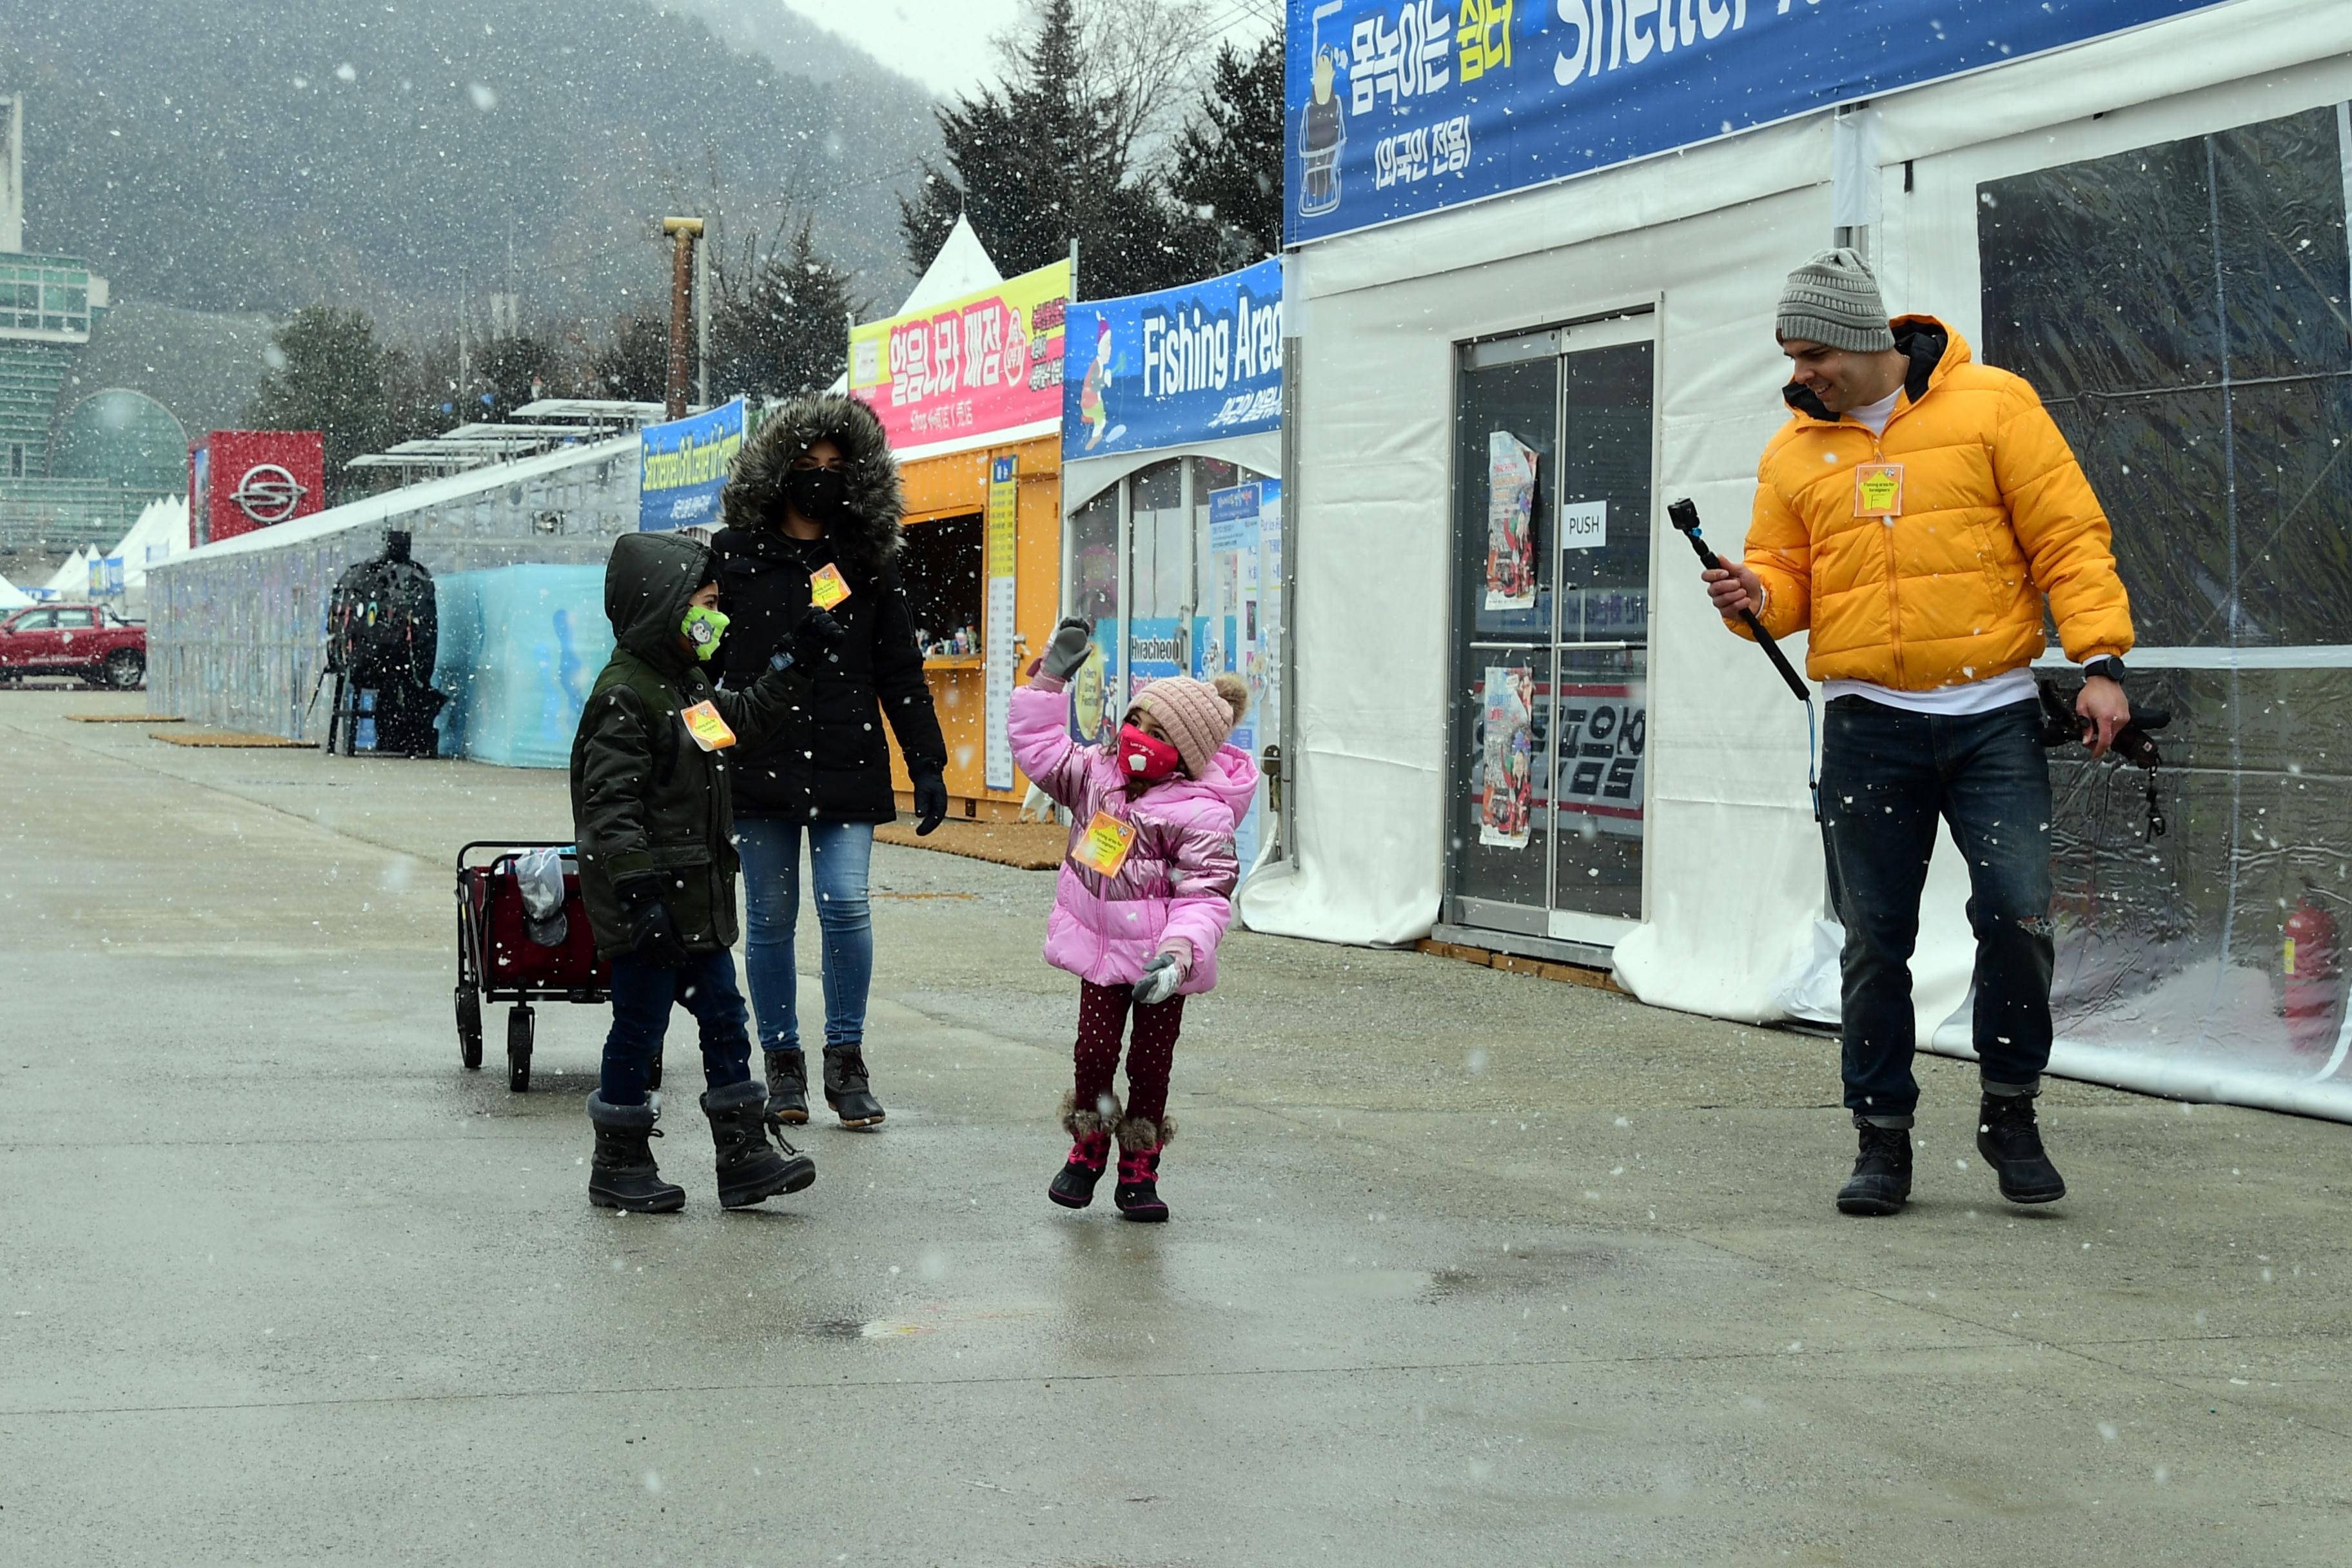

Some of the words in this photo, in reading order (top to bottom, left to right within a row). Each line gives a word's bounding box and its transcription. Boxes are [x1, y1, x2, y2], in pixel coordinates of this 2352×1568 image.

[1456, 0, 1513, 83] 쉼터
[963, 305, 1001, 388] 매점
[1144, 308, 1229, 397] Fishing
[1569, 516, 1599, 534] PUSH
